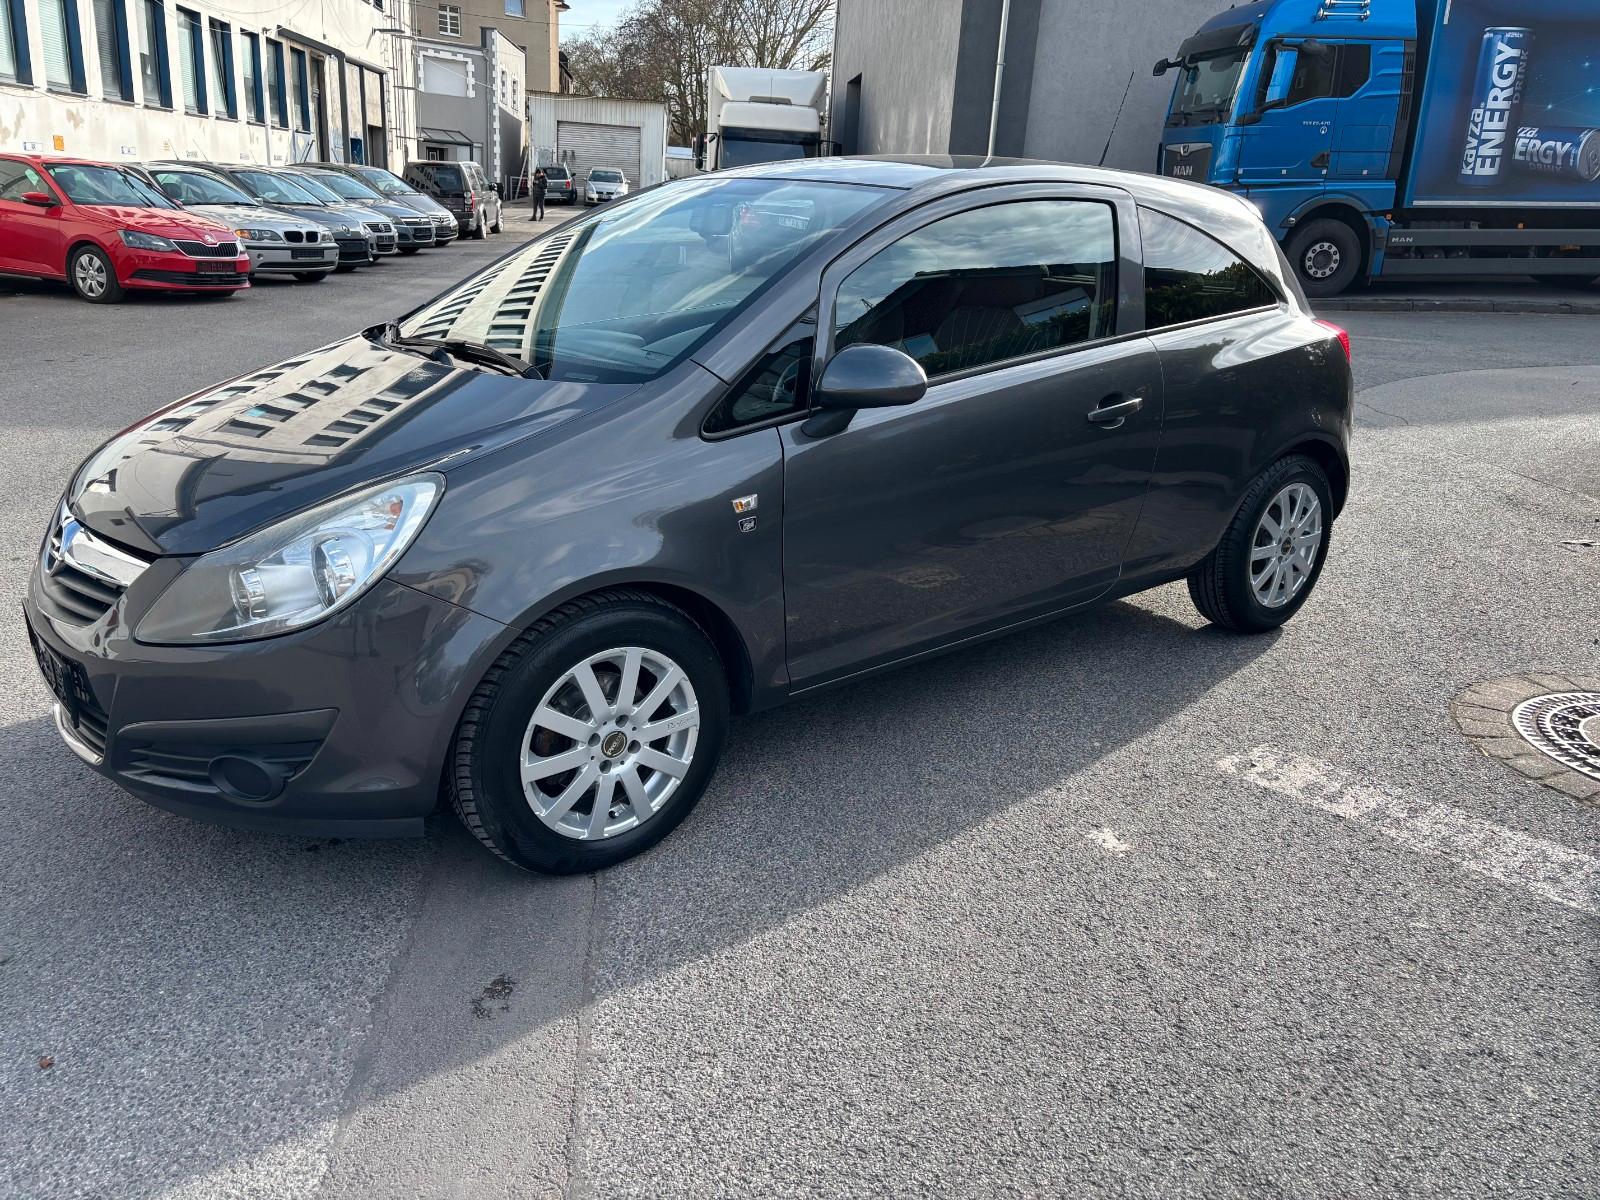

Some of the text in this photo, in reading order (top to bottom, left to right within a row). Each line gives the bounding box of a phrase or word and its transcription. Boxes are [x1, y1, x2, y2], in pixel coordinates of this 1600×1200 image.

[1513, 50, 1529, 104] DRINK
[1474, 41, 1521, 176] ENERGY
[1173, 165, 1193, 177] MAN
[1513, 137, 1573, 166] ERGY
